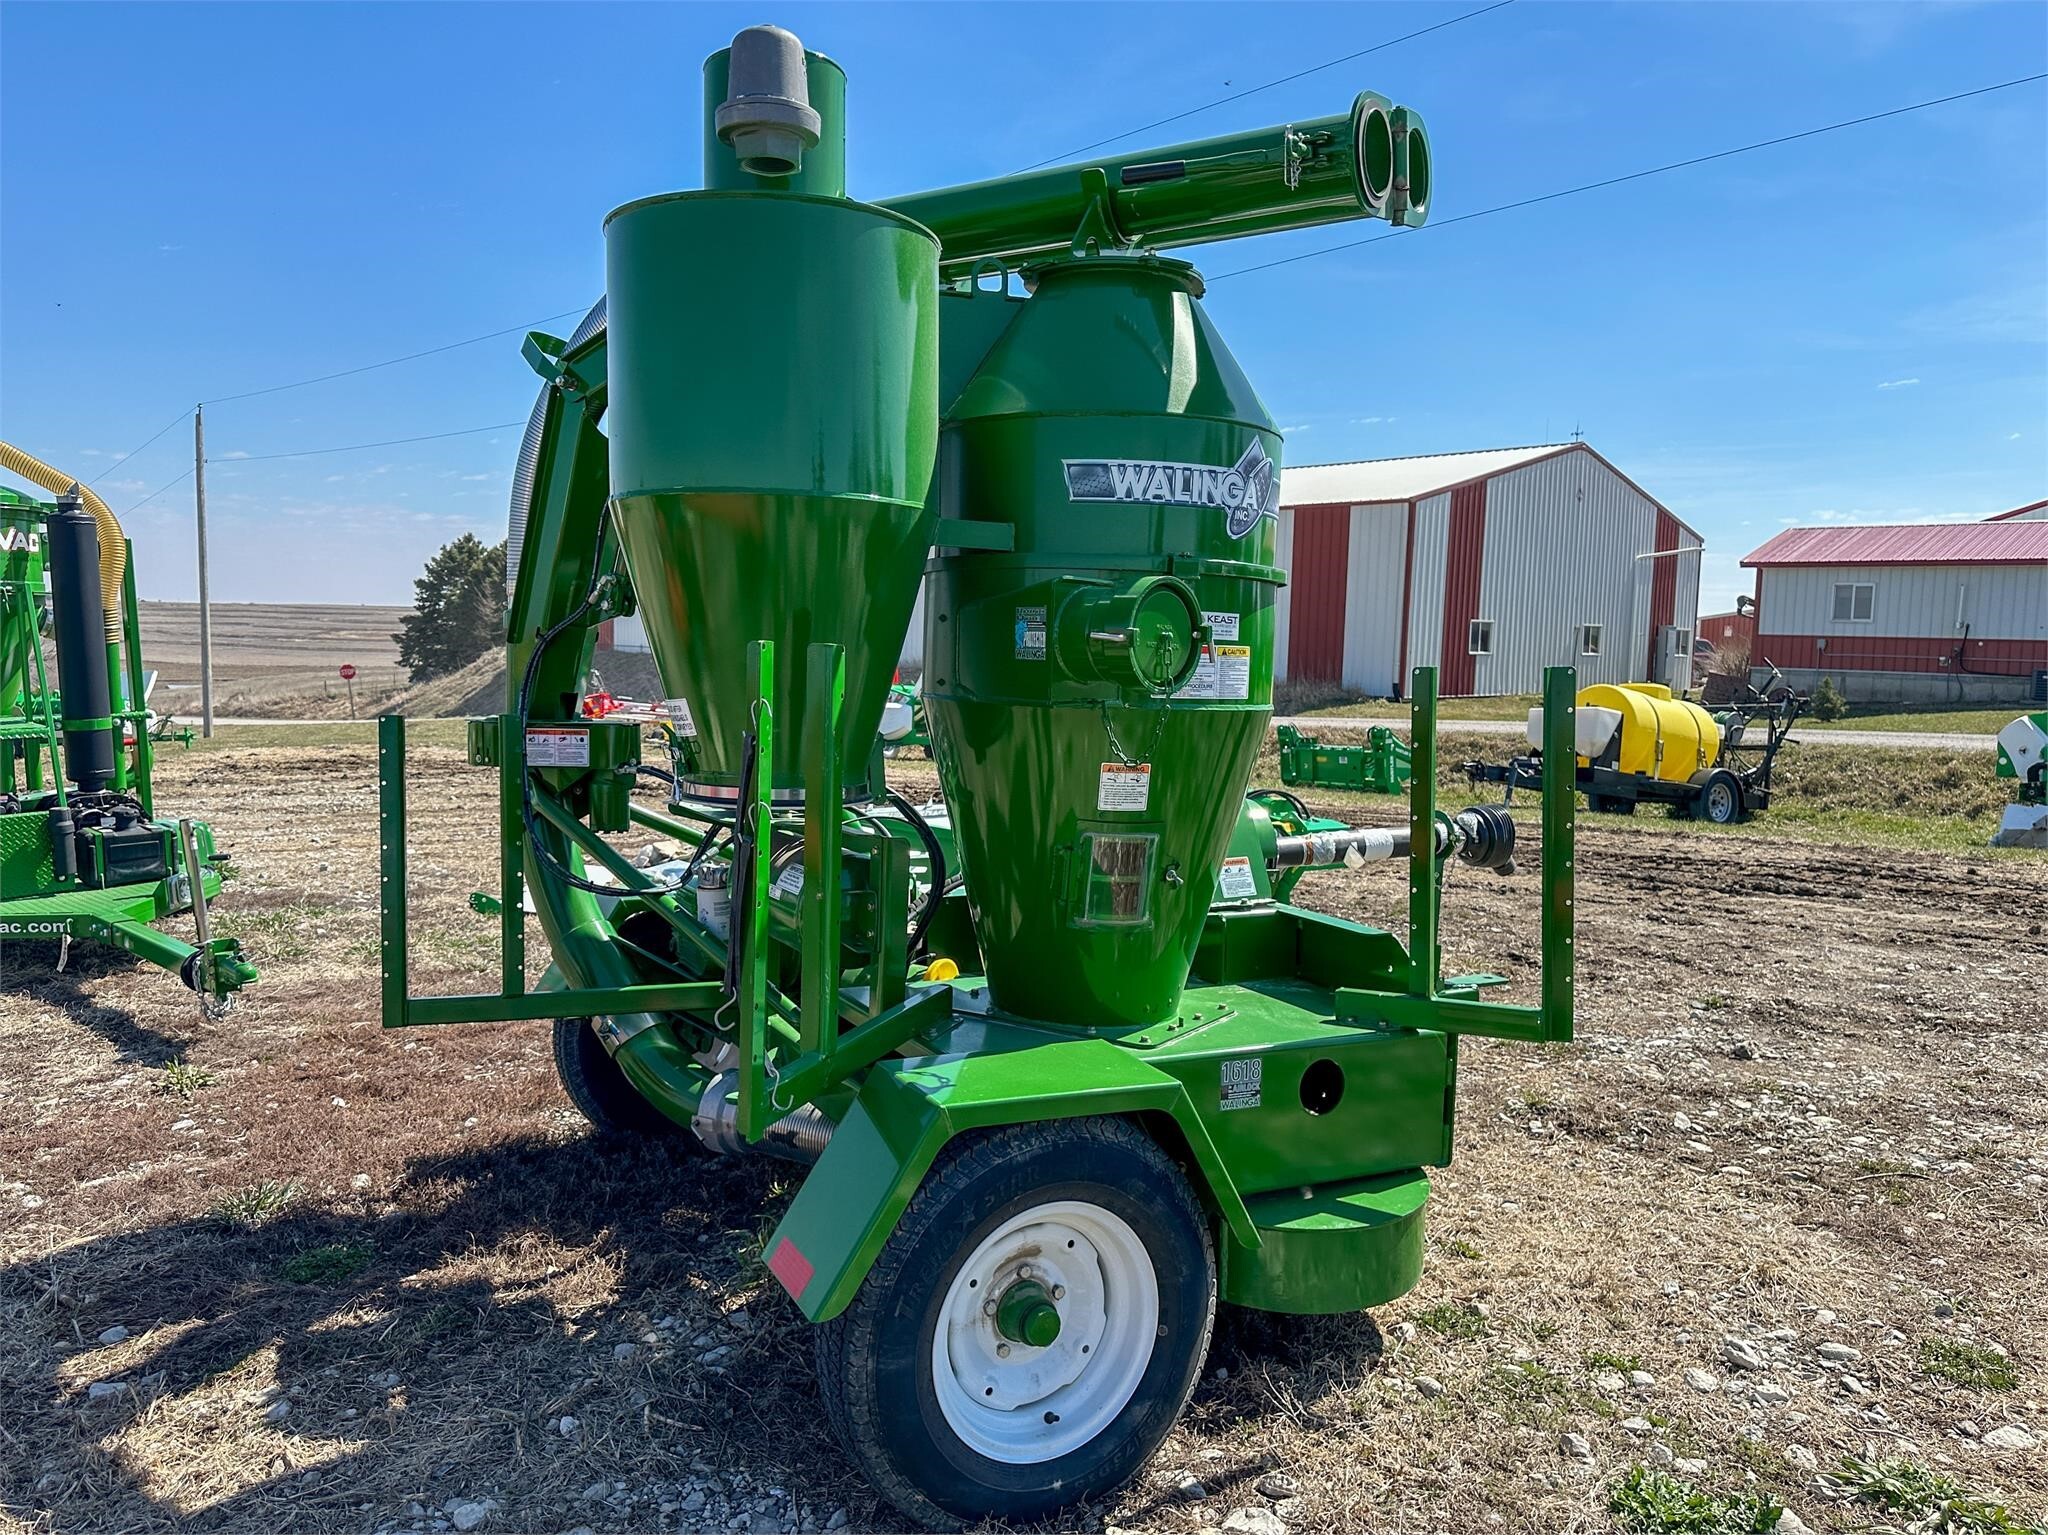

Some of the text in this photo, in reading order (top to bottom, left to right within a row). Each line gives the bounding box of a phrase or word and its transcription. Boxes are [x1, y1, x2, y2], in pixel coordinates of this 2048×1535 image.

[1110, 464, 1258, 510] WALINGA
[1234, 509, 1250, 521] INC.
[1207, 614, 1238, 624] KEAST
[1227, 648, 1247, 656] CAUTION
[1221, 1059, 1262, 1083] 1618
[1221, 1097, 1260, 1109] WALINGA
